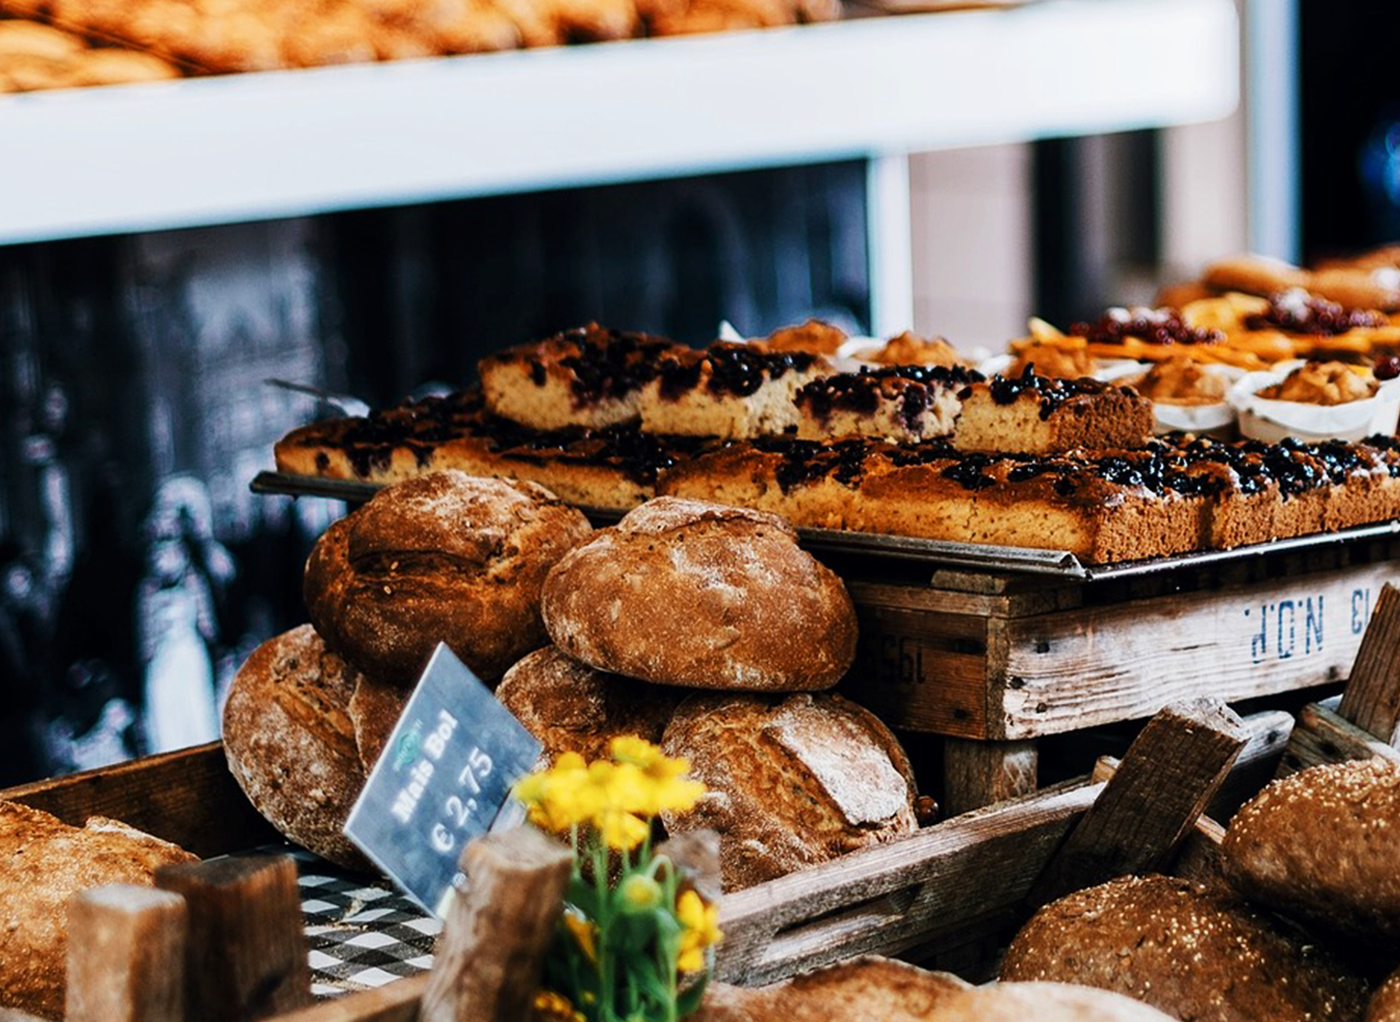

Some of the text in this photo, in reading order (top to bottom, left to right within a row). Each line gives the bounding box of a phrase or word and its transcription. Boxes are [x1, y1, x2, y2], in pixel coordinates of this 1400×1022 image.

[391, 759, 434, 823] Mais
[424, 709, 458, 760] Bol
[446, 747, 493, 826] 2,75
